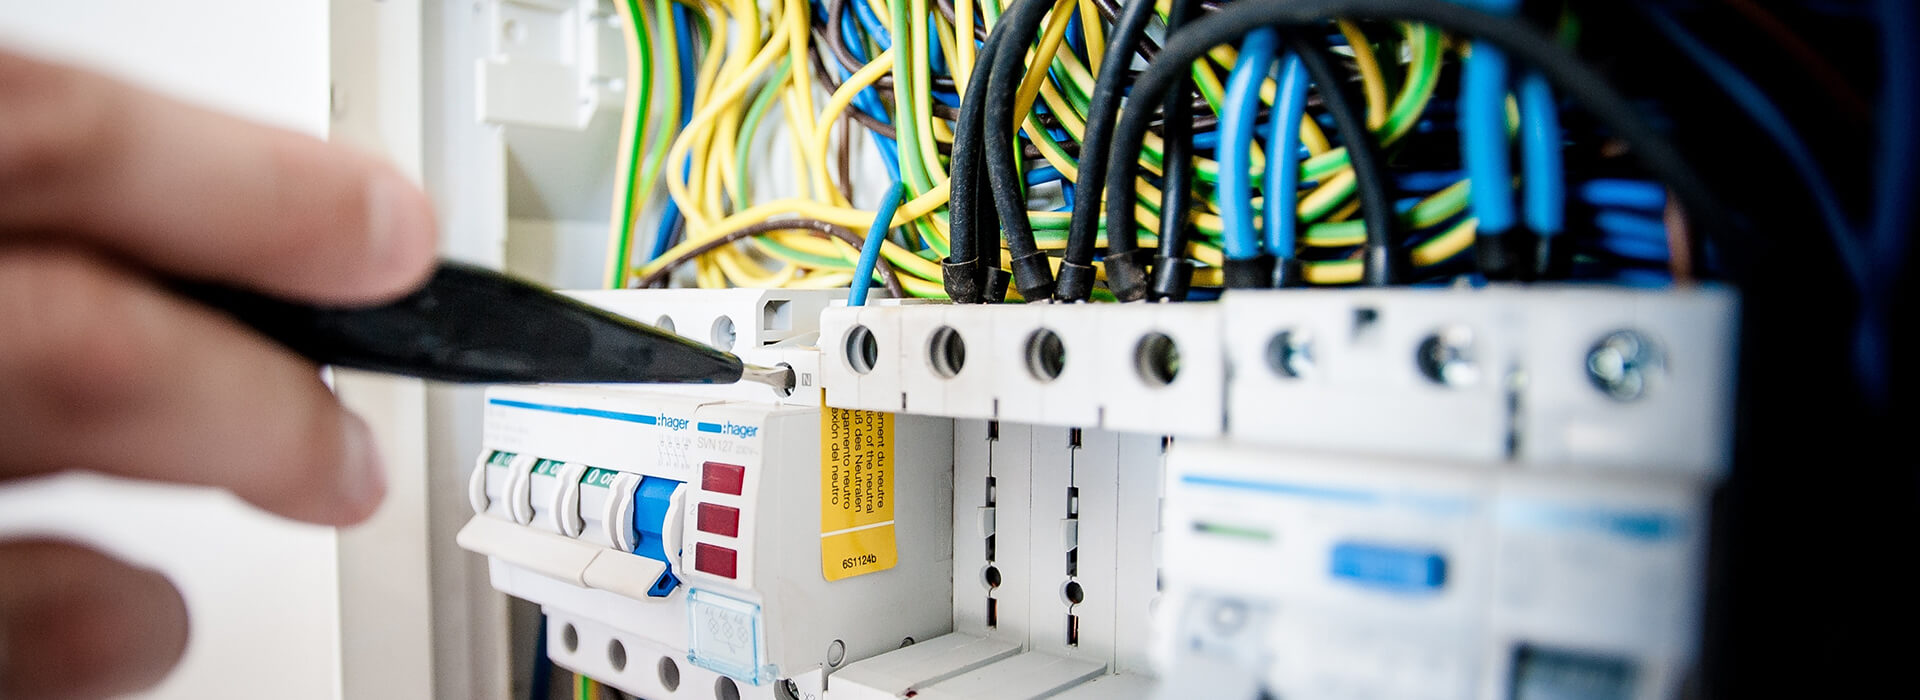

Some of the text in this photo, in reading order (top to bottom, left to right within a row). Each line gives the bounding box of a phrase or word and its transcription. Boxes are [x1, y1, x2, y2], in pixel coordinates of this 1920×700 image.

[802, 373, 811, 386] N
[854, 429, 864, 452] des
[866, 435, 875, 447] of
[831, 443, 840, 462] del
[866, 450, 875, 470] the
[877, 451, 886, 467] du
[831, 465, 839, 505] neutro
[843, 470, 851, 510] neutro
[854, 454, 864, 513] Neutralen
[866, 473, 874, 514] neutral
[876, 470, 885, 509] neutre
[842, 553, 877, 570] 6S1124b
